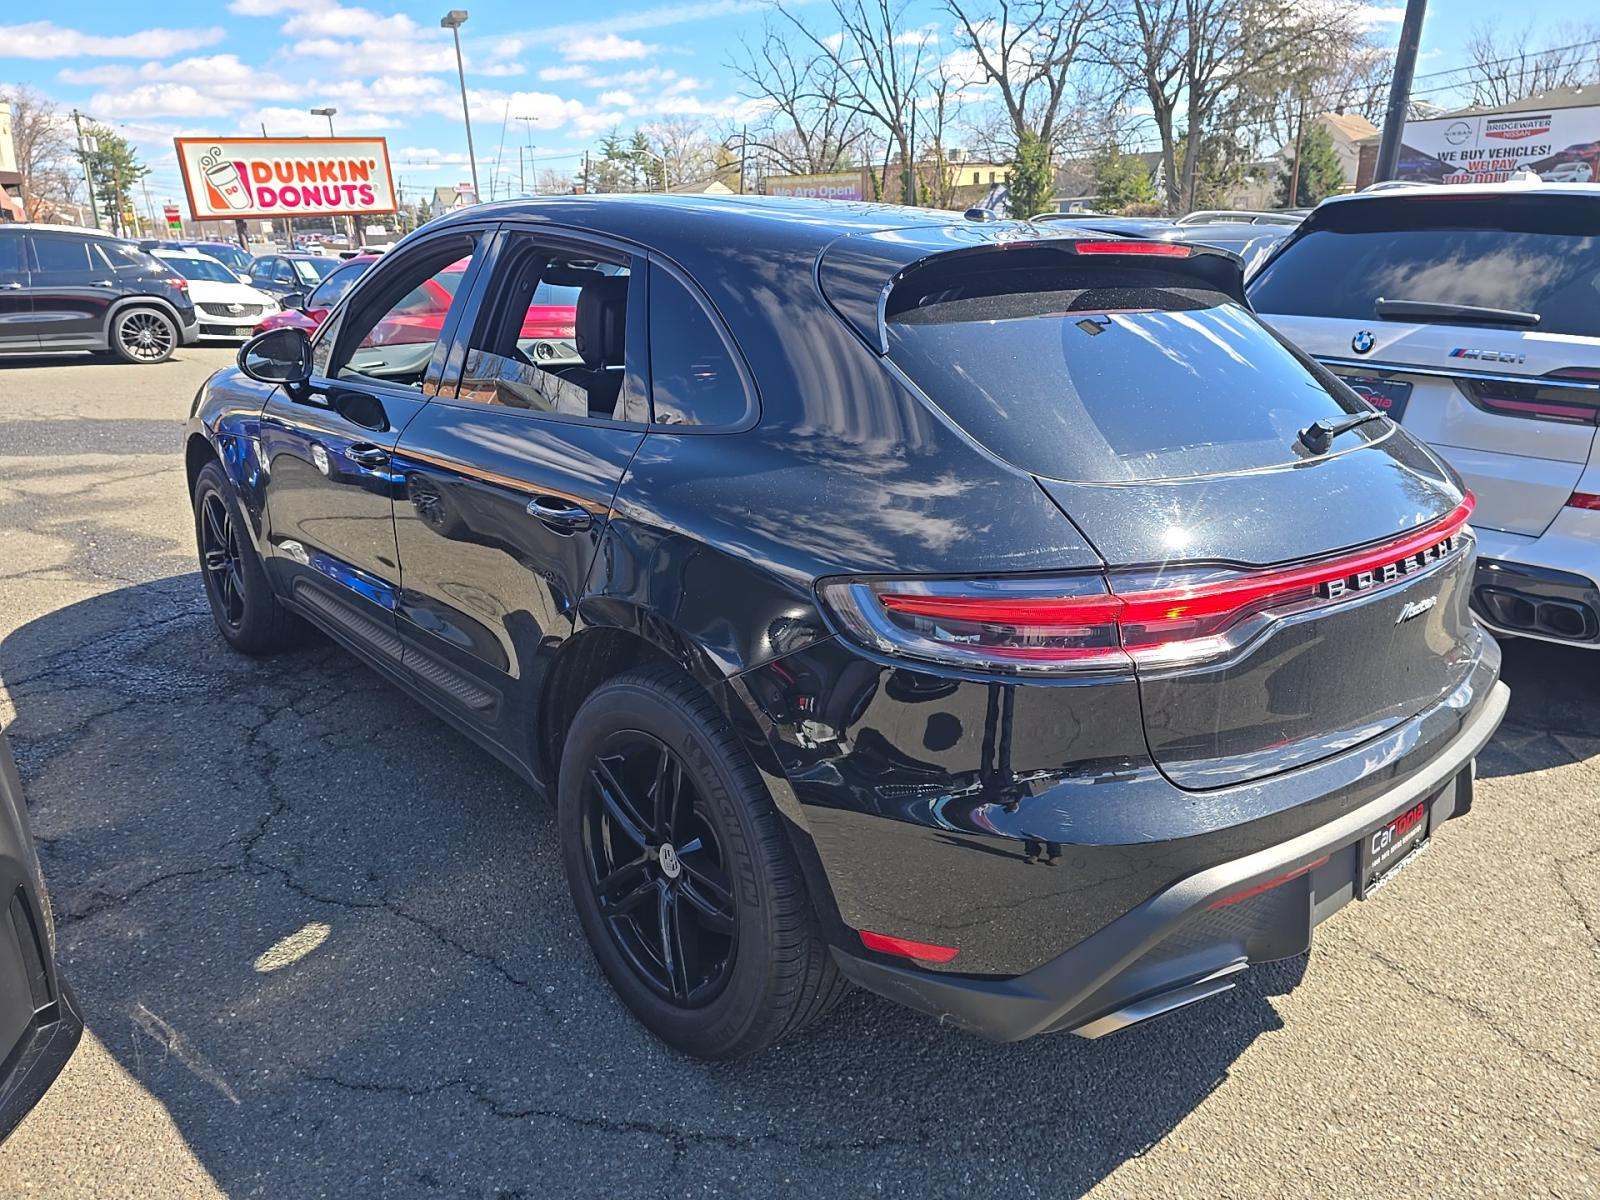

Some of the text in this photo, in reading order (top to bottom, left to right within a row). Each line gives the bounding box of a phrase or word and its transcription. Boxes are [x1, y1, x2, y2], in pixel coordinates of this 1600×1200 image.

[1486, 119, 1552, 131] BRIDGEWATER
[1503, 129, 1531, 138] NISSAN
[1438, 145, 1552, 161] WE BUY VEHICLES!
[251, 160, 376, 184] DUNKIN'
[1468, 160, 1488, 171] WE
[257, 184, 375, 208] DONUTS
[773, 184, 855, 198] We Are Open!
